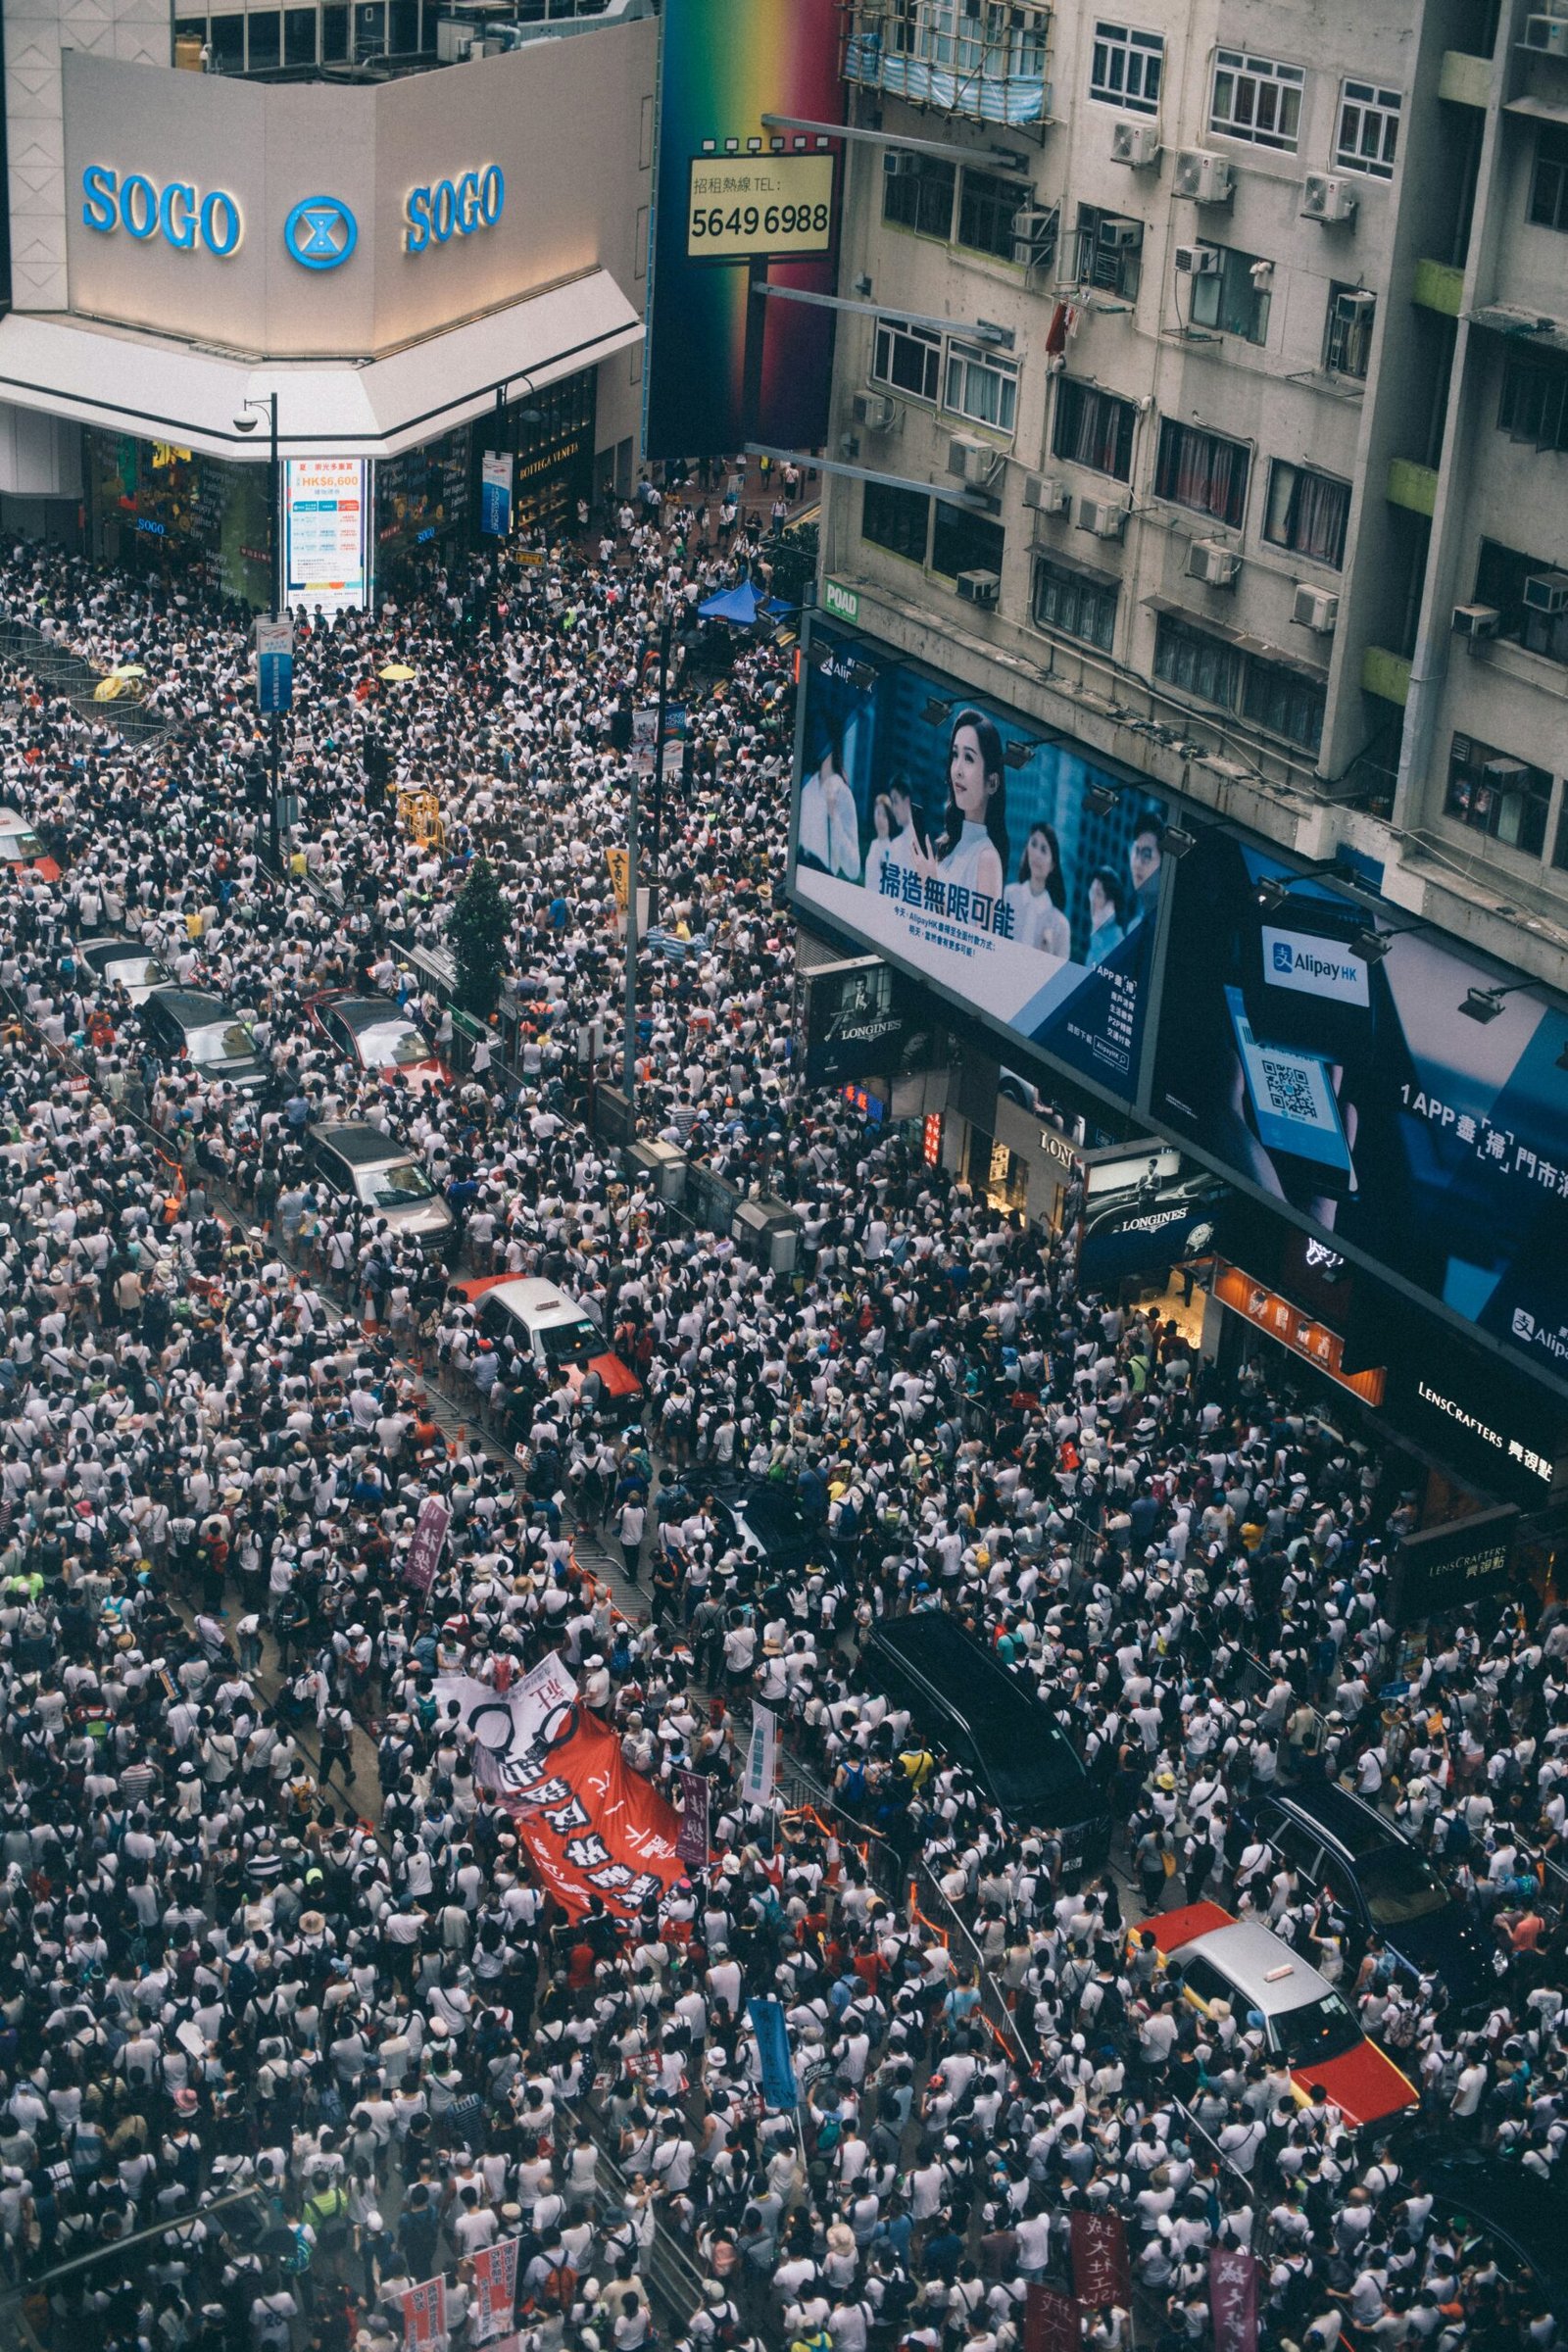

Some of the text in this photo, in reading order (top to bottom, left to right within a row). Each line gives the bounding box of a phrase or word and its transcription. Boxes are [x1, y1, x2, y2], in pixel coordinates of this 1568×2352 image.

[693, 176, 751, 194] 招租熱線
[83, 165, 242, 257] SOGO
[406, 164, 506, 253] SOGO
[691, 204, 828, 237] 5649 6988
[519, 442, 579, 480] BOTTEGA VENETA
[302, 476, 359, 488] HK$6,600
[137, 517, 165, 535] SOGO
[827, 584, 857, 615] POAD
[879, 861, 1015, 940] 掃造無限可能
[1098, 965, 1114, 981] APP
[1294, 952, 1340, 980] Alipay
[842, 1019, 903, 1041] LONGINES
[1400, 1084, 1409, 1104] 1
[1413, 1092, 1455, 1127] APP
[1122, 1207, 1188, 1232] LONGINES
